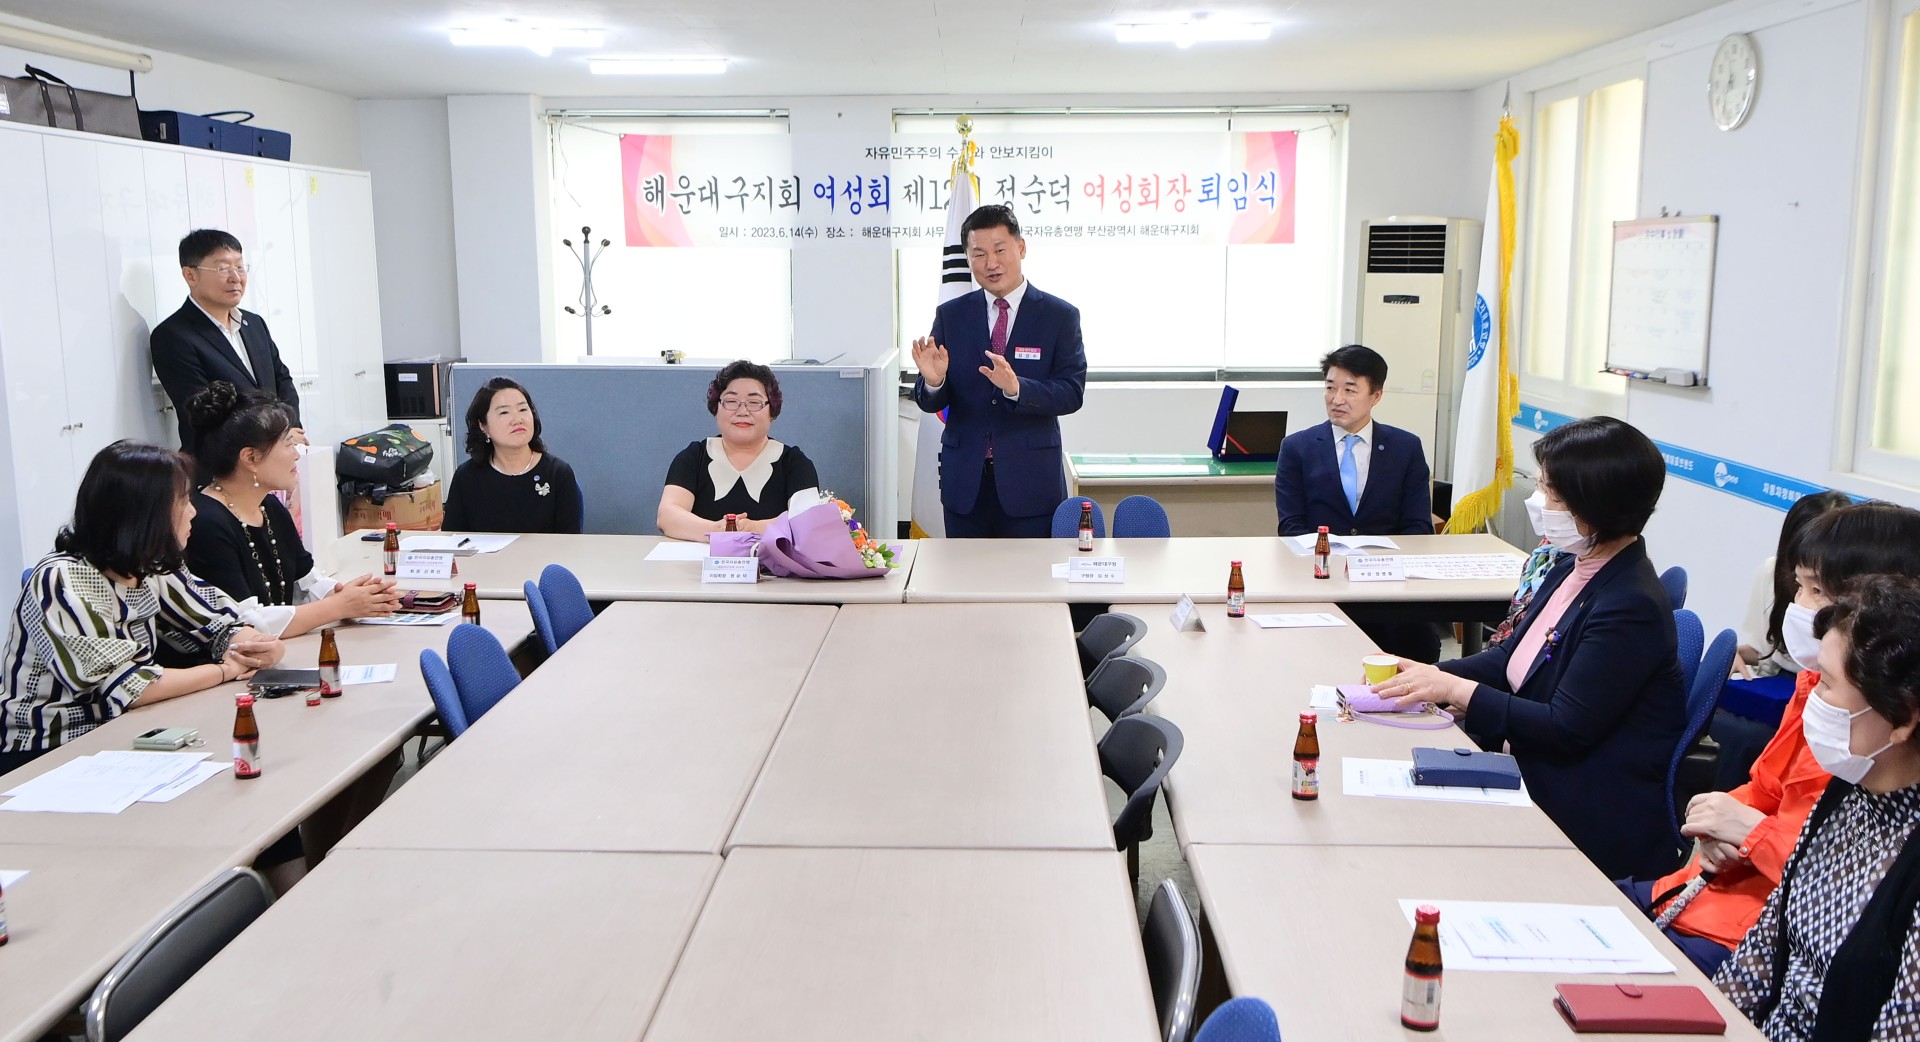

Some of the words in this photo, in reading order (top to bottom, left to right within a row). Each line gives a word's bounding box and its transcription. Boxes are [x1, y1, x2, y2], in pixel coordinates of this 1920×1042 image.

[865, 146, 942, 160] 자유민주주의
[946, 146, 985, 160] 수와
[990, 145, 1053, 160] 안보지킴이
[642, 174, 801, 215] 해운대구지회
[813, 174, 890, 215] 여성회
[902, 174, 981, 214] 제12
[994, 173, 1071, 215] 정순덕
[719, 226, 739, 238] 일시
[751, 226, 818, 239] 2023.6.14(수)
[826, 226, 846, 238] 장소
[861, 226, 921, 238] 해운대구지회
[925, 226, 945, 238] 사무
[1087, 225, 1136, 237] 부산광역시
[1140, 224, 1200, 236] 해운대구지회
